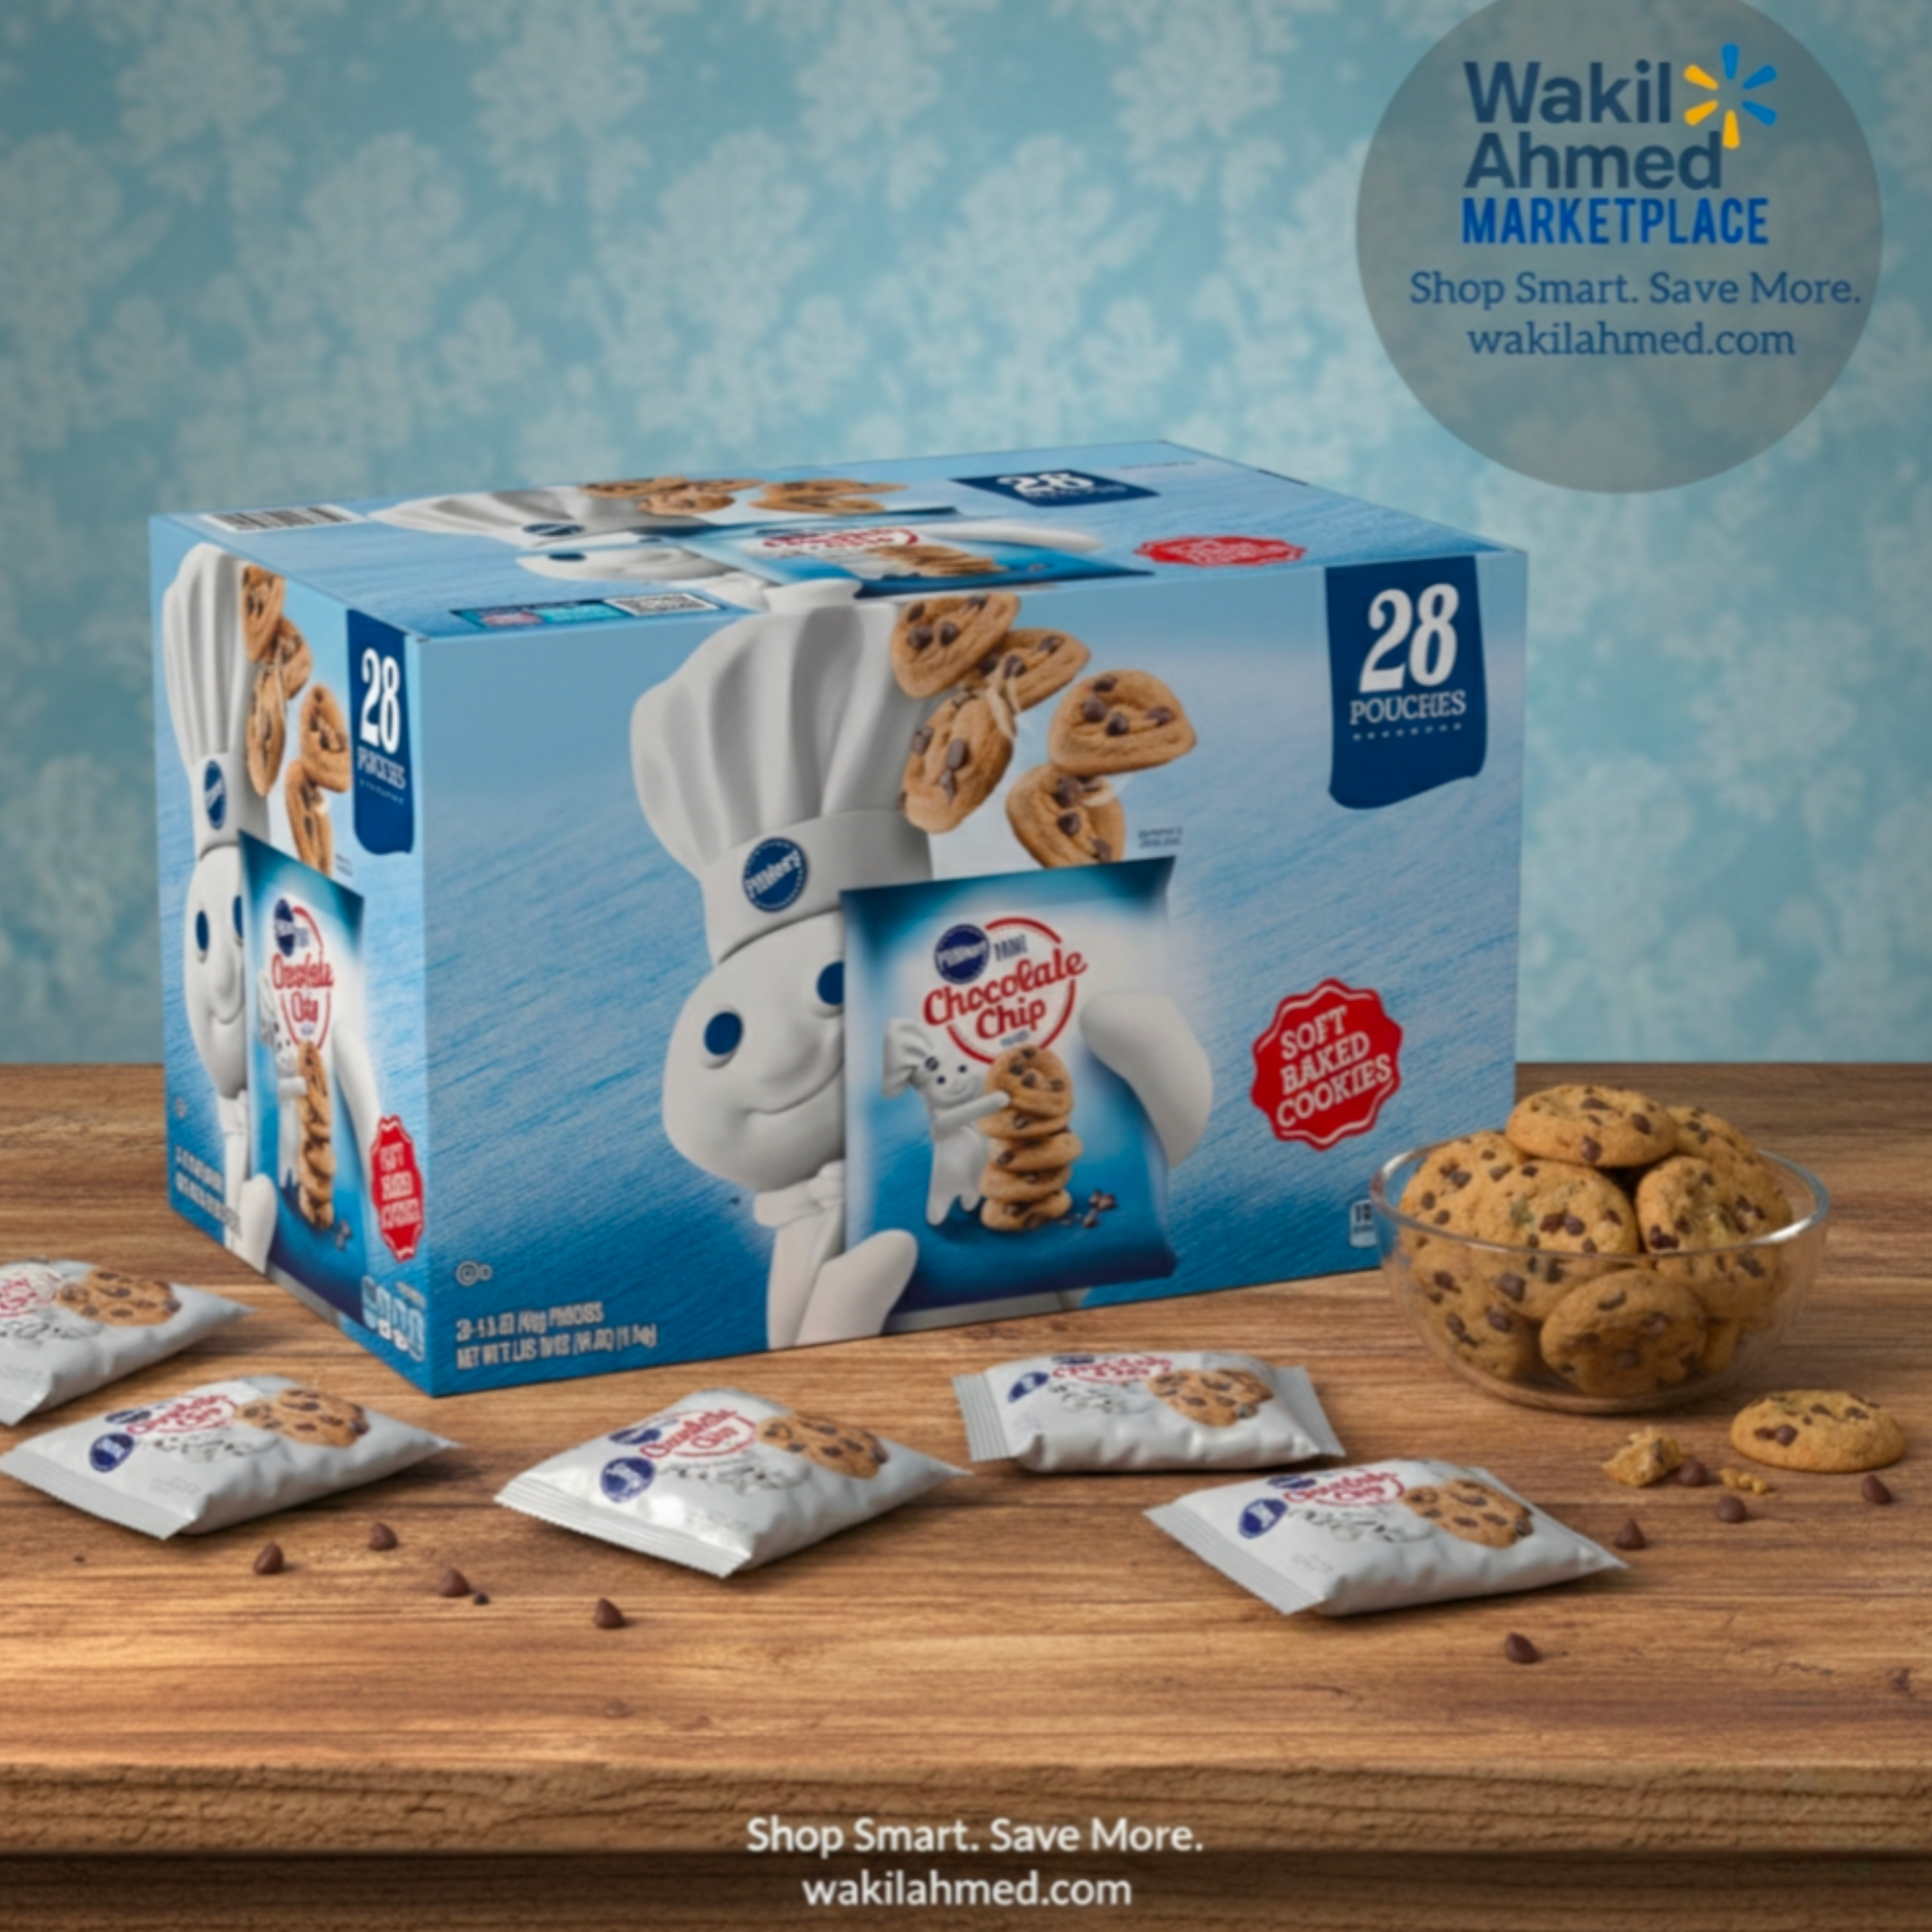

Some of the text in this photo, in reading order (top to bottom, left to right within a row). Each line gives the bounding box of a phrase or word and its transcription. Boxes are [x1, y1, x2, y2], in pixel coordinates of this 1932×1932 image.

[996, 473, 1095, 496] 28
[1359, 583, 1460, 693] 28
[359, 647, 401, 755] 28
[1349, 690, 1467, 726] POUCHES
[923, 948, 1088, 1026] Chocolate
[976, 997, 1046, 1039] Chip
[1280, 1006, 1347, 1060] SOFT
[1280, 1032, 1370, 1095] BAKED
[1277, 1054, 1392, 1127] COOKIES
